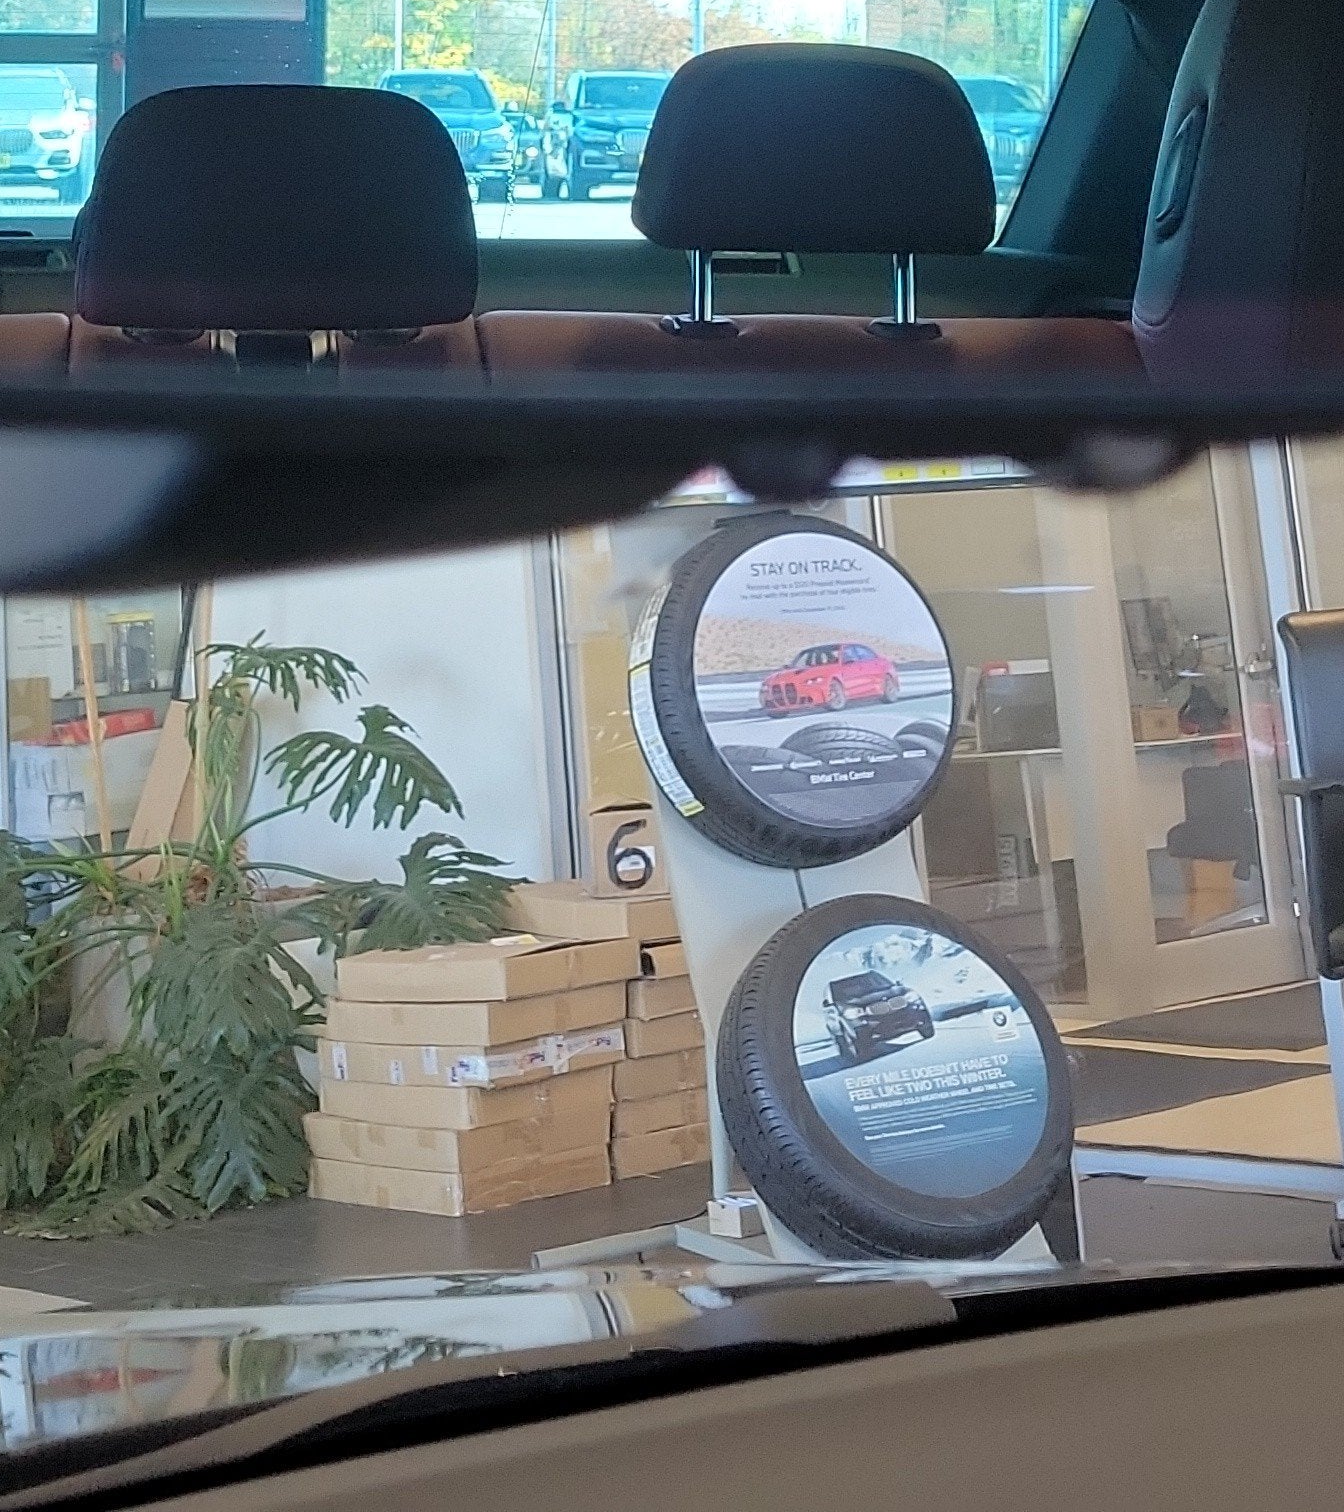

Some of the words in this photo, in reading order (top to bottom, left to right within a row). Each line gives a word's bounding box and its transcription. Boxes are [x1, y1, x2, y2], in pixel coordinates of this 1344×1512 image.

[750, 561, 784, 577] STAY
[787, 560, 808, 575] ON
[607, 818, 655, 890] 6
